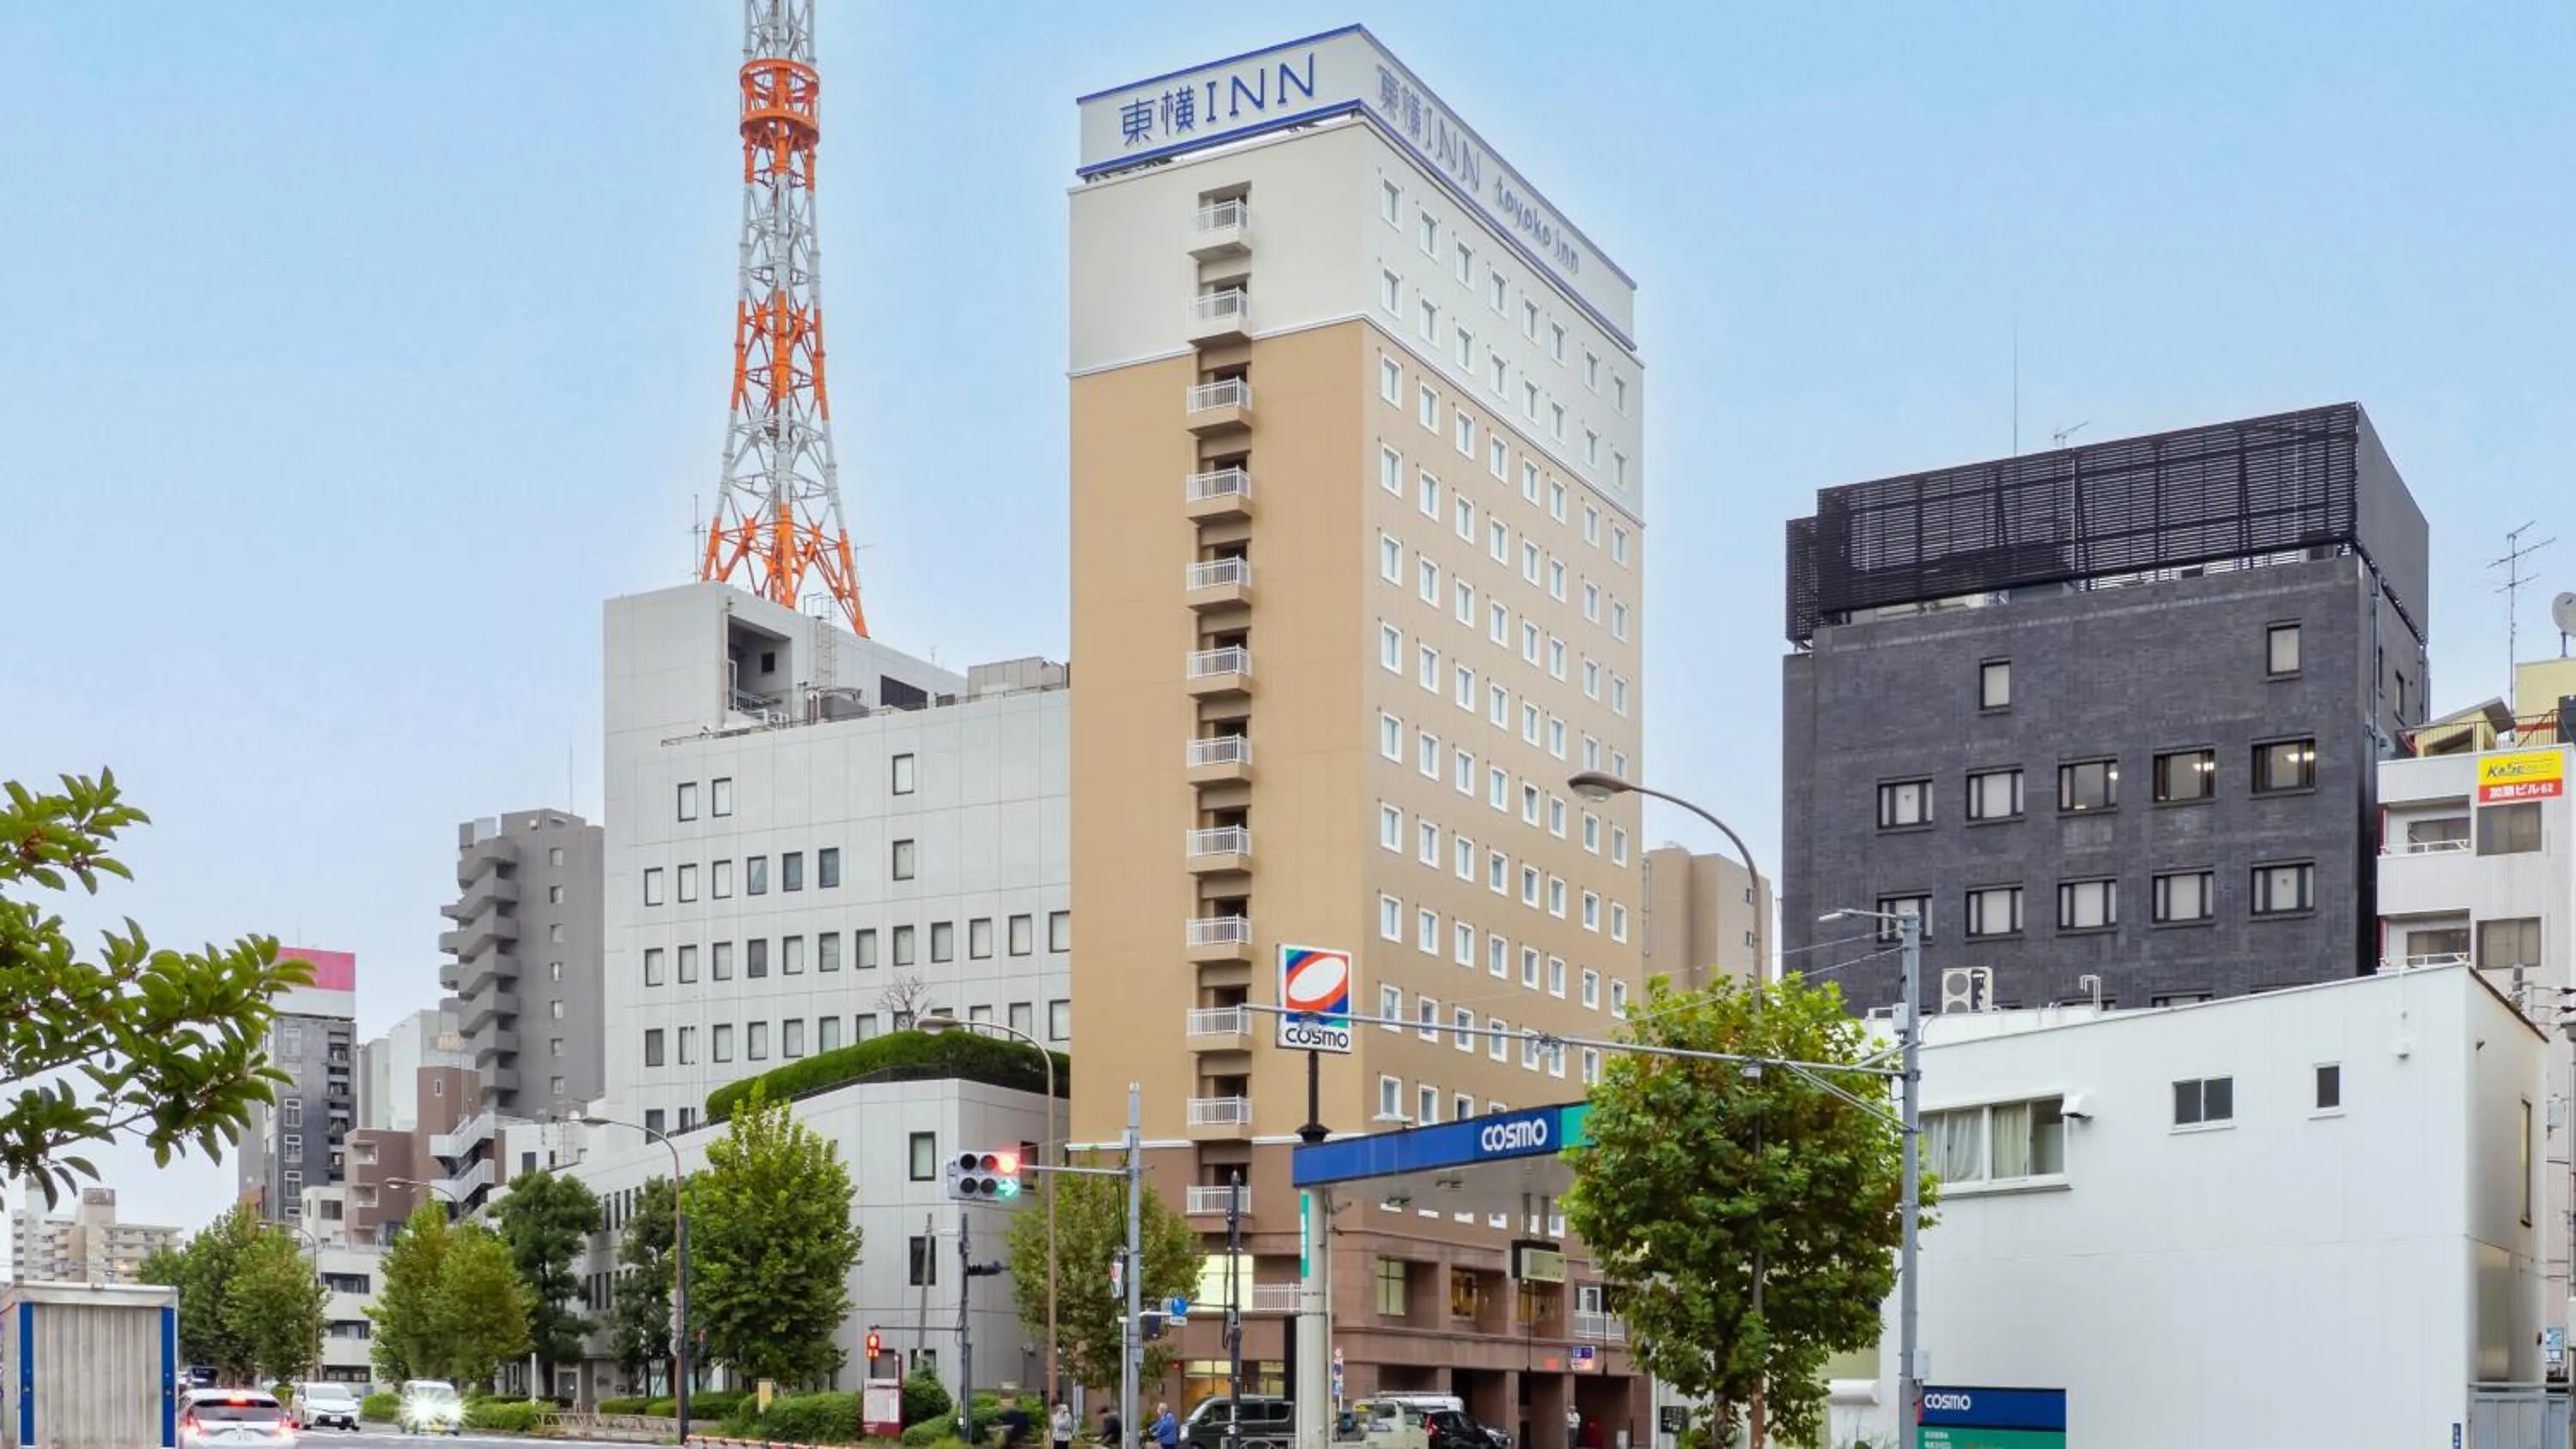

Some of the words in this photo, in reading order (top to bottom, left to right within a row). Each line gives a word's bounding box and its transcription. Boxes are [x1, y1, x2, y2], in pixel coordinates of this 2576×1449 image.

[1119, 52, 1315, 147] 東横INN
[1376, 64, 1479, 193] 東横INN
[1494, 177, 1552, 247] toyoko
[1554, 228, 1579, 276] inn
[1285, 1028, 1349, 1048] COSMO
[1481, 1118, 1547, 1151] COSMO
[1923, 1393, 1971, 1410] COSMO
